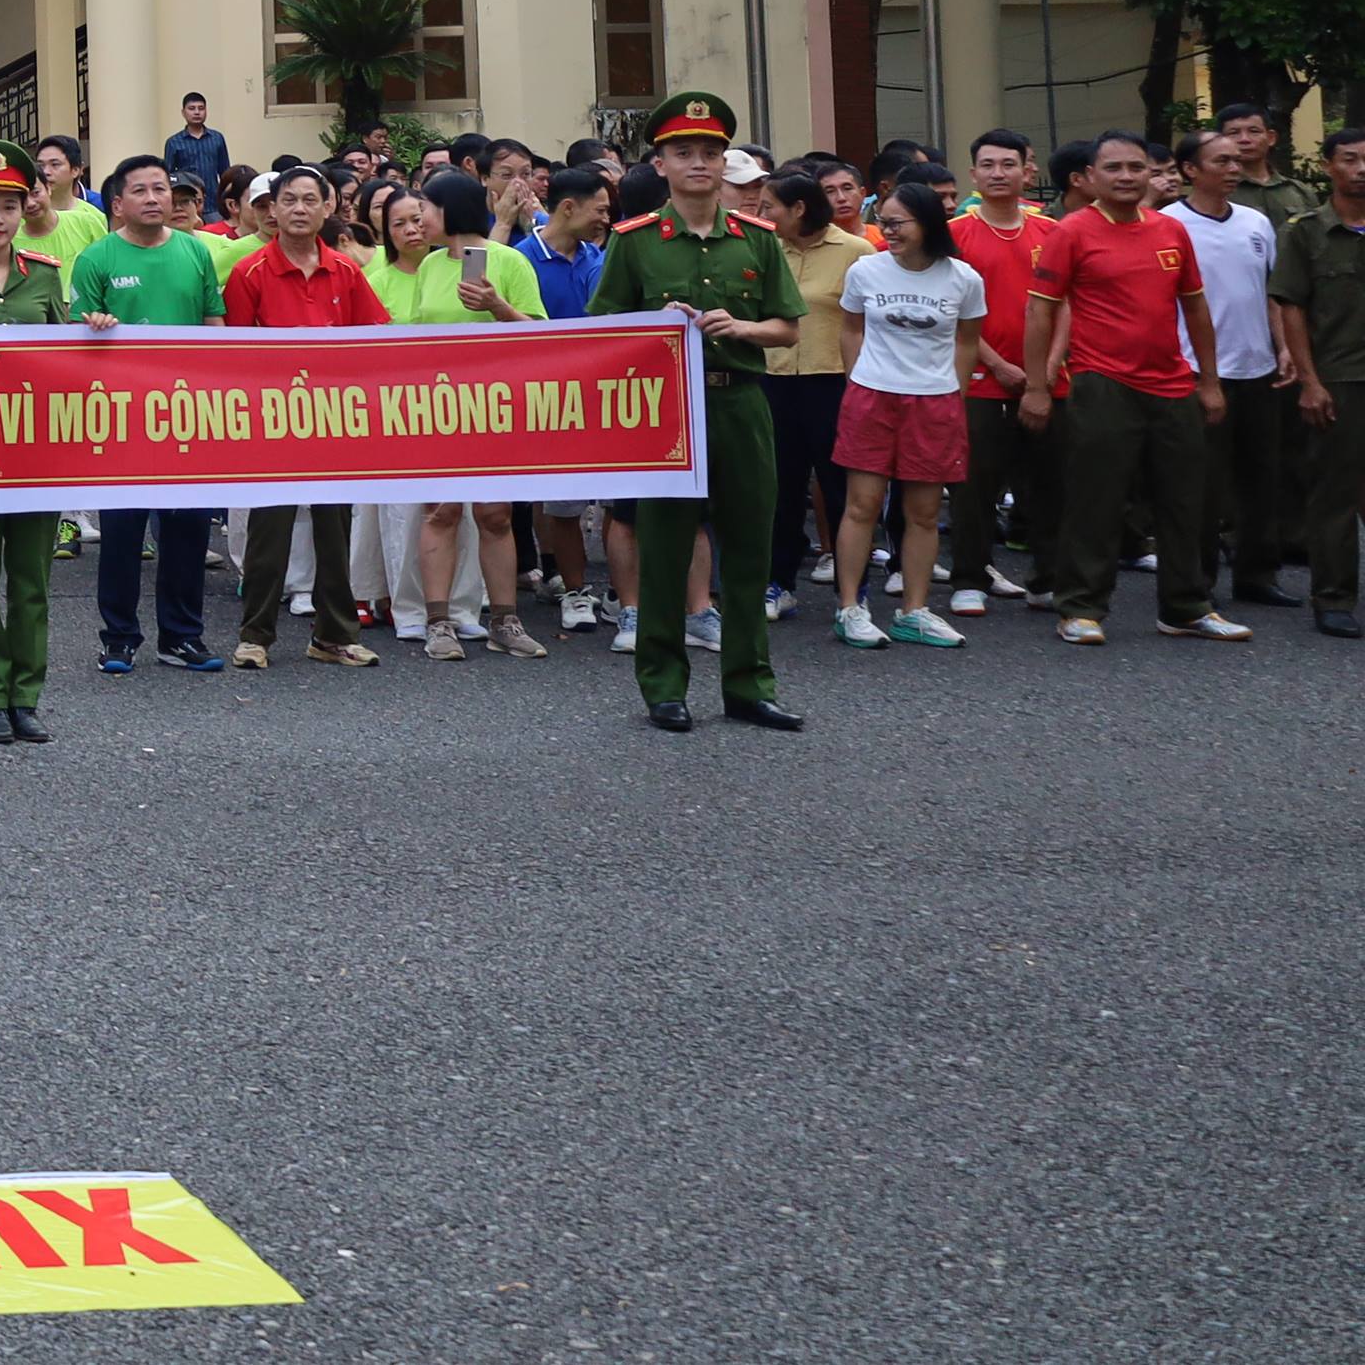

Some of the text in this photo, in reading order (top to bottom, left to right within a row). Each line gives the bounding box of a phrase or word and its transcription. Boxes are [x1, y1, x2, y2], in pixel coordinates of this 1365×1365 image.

[49, 381, 132, 454] MỘT
[144, 379, 251, 453] CỘNG
[261, 369, 369, 439] ĐỒNG
[379, 373, 513, 436] KHÔNG
[525, 380, 586, 432] MA
[597, 367, 665, 429] TÚY
